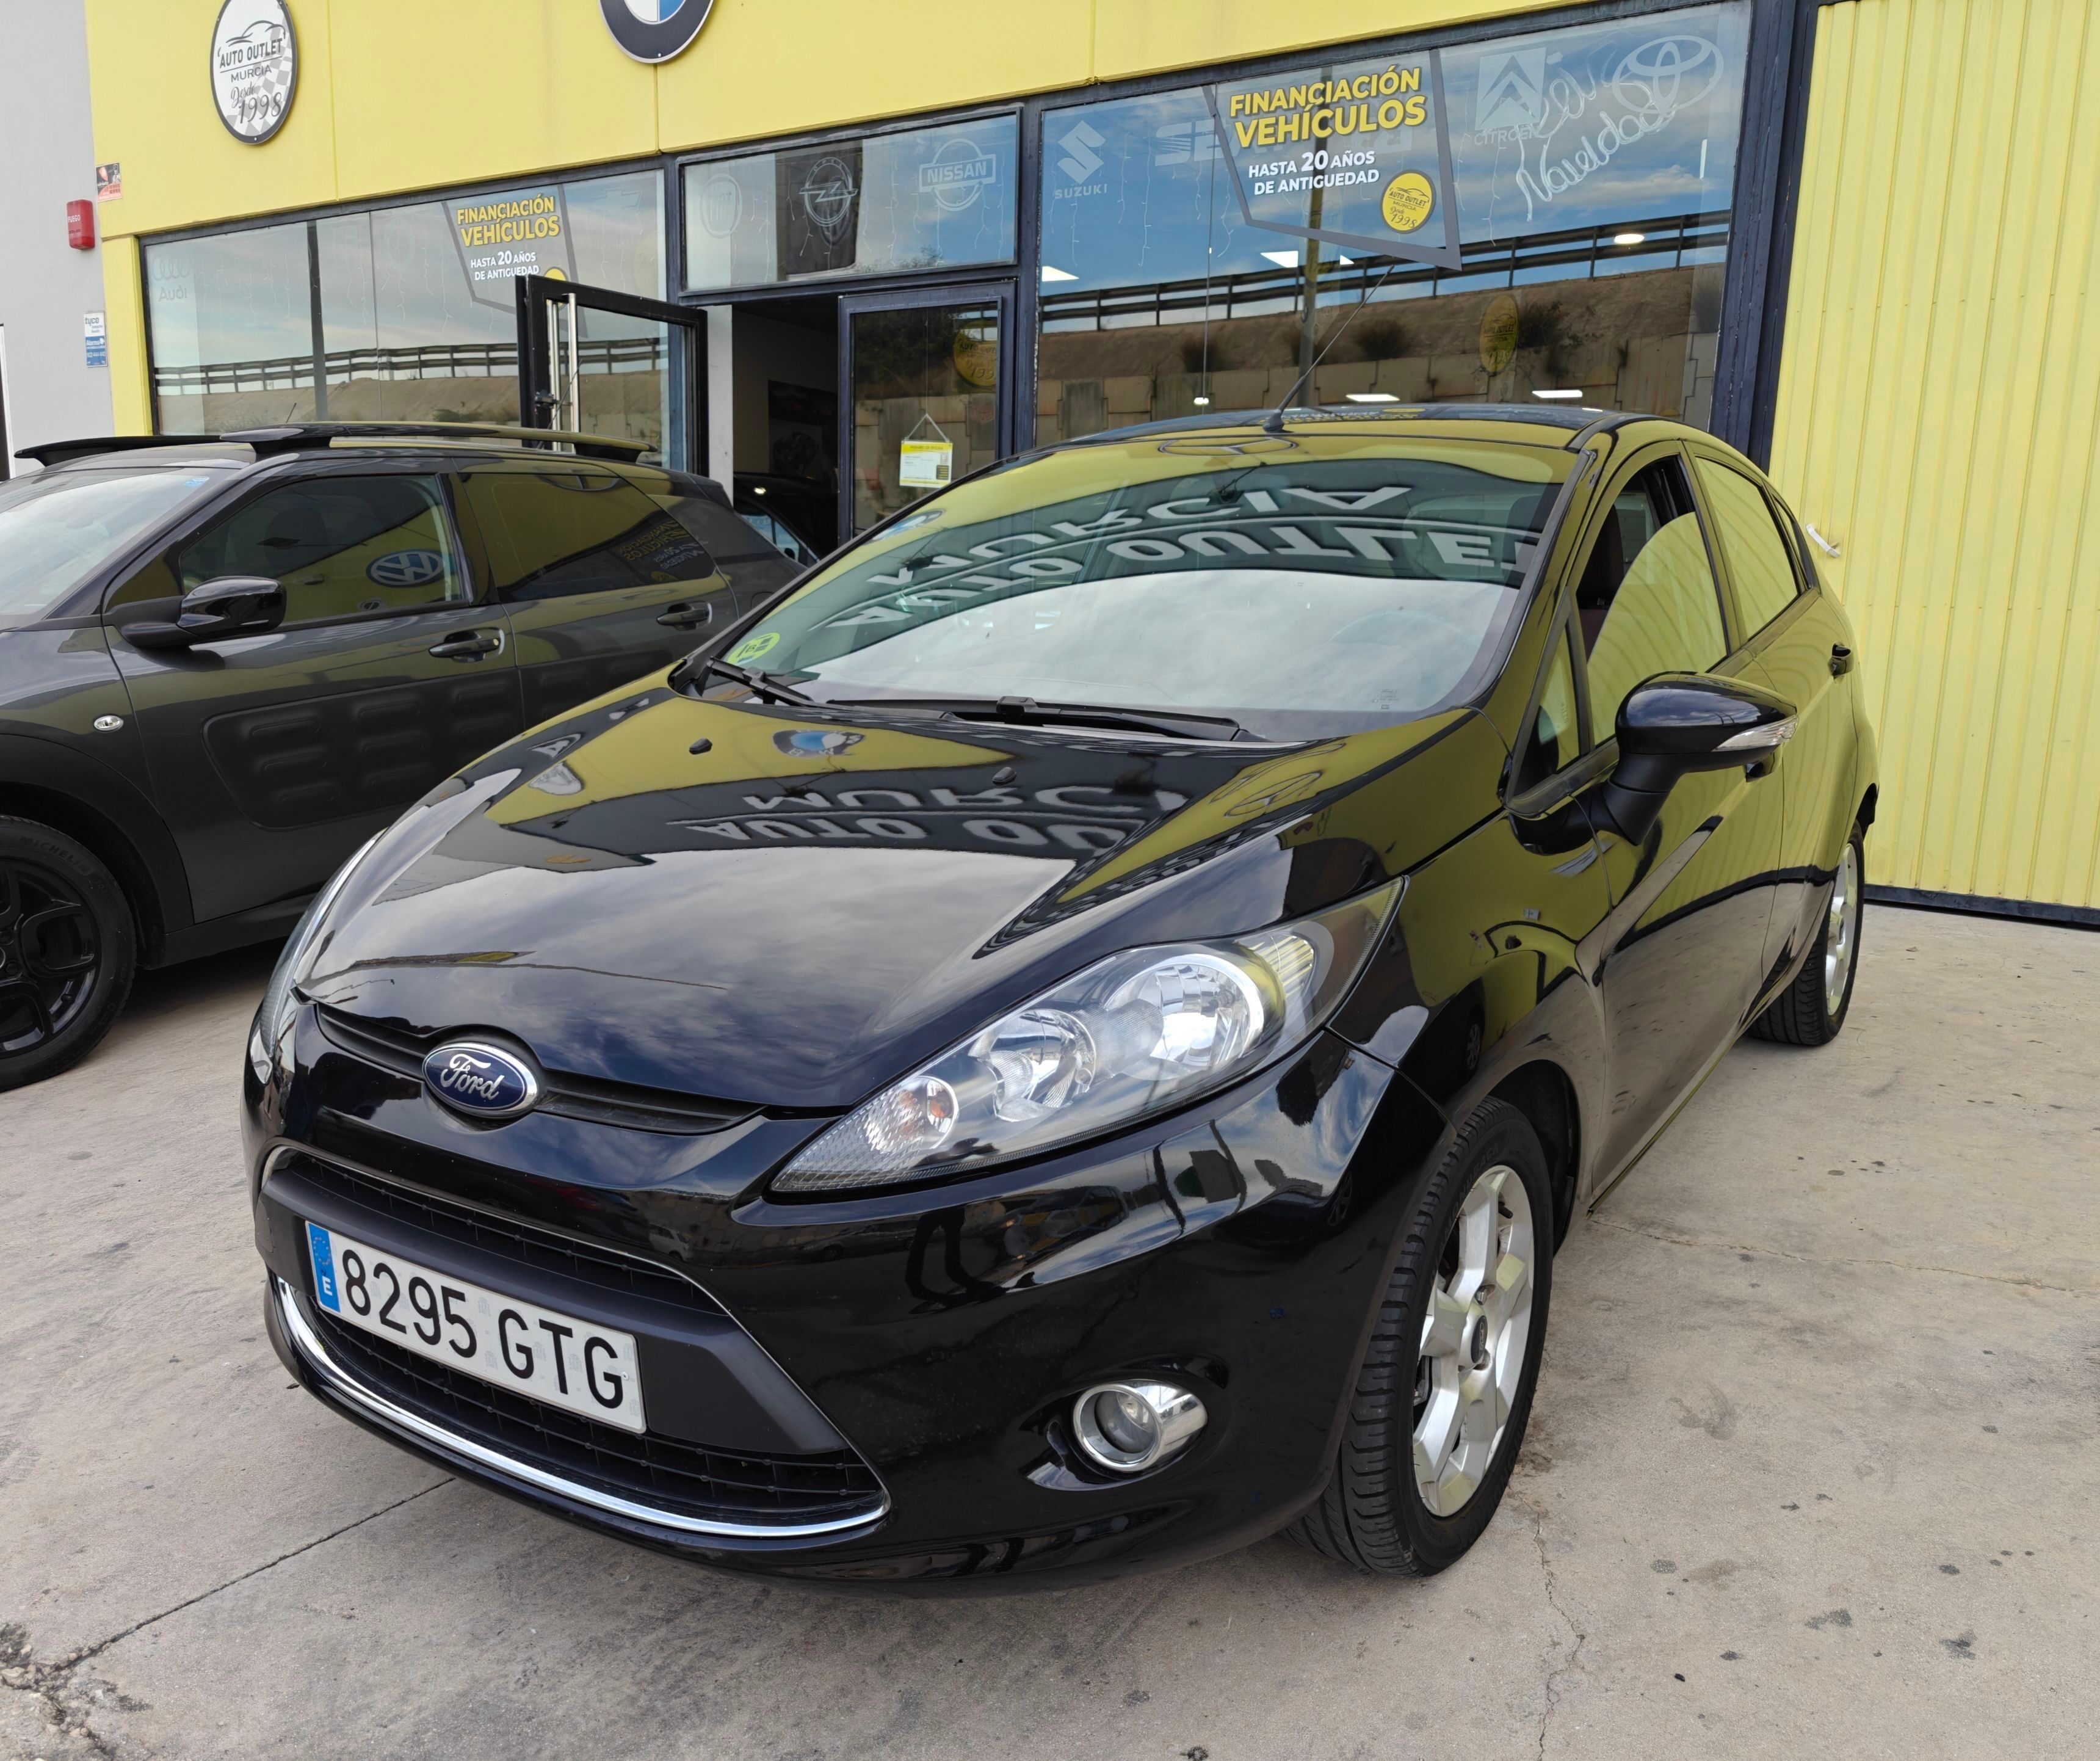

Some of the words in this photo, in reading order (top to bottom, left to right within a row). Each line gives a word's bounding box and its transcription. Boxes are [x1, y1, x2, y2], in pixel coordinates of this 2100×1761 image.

[220, 49, 243, 68] AUTO
[247, 38, 283, 60] OUTLET
[231, 64, 272, 82] MURCIA
[1230, 65, 1421, 117] FINANCIACIÓN
[239, 92, 281, 124] 1998
[1236, 95, 1427, 147] VEHÍCULOS
[927, 161, 987, 183] NISSAN
[1248, 161, 1297, 178] HASTA
[1301, 150, 1329, 172] 20
[1330, 150, 1375, 168] AÑOS
[1054, 184, 1107, 198] SUZUKI
[1255, 181, 1275, 195] DE
[1278, 169, 1380, 191] ANTIGUEDAD
[457, 193, 555, 225] FINANCIACIÓN
[1389, 191, 1404, 200] AUTO
[1405, 195, 1427, 206] OUTLET
[1392, 201, 1416, 211] MURCIA
[461, 215, 560, 247] VEHÍCULOS
[1391, 213, 1417, 228] 1998
[471, 257, 496, 268] HASTA
[498, 250, 512, 265] 20
[513, 251, 536, 263] AÑOS
[474, 271, 485, 280] DE
[487, 265, 539, 280] ANTIGUEDAD
[85, 317, 100, 326] tyco
[969, 367, 995, 380] 199
[20, 836, 90, 872] MICHELIN
[440, 1053, 505, 1100] Ford
[322, 1275, 333, 1296] E
[342, 1249, 477, 1359] 8295
[498, 1308, 623, 1409] GTG
